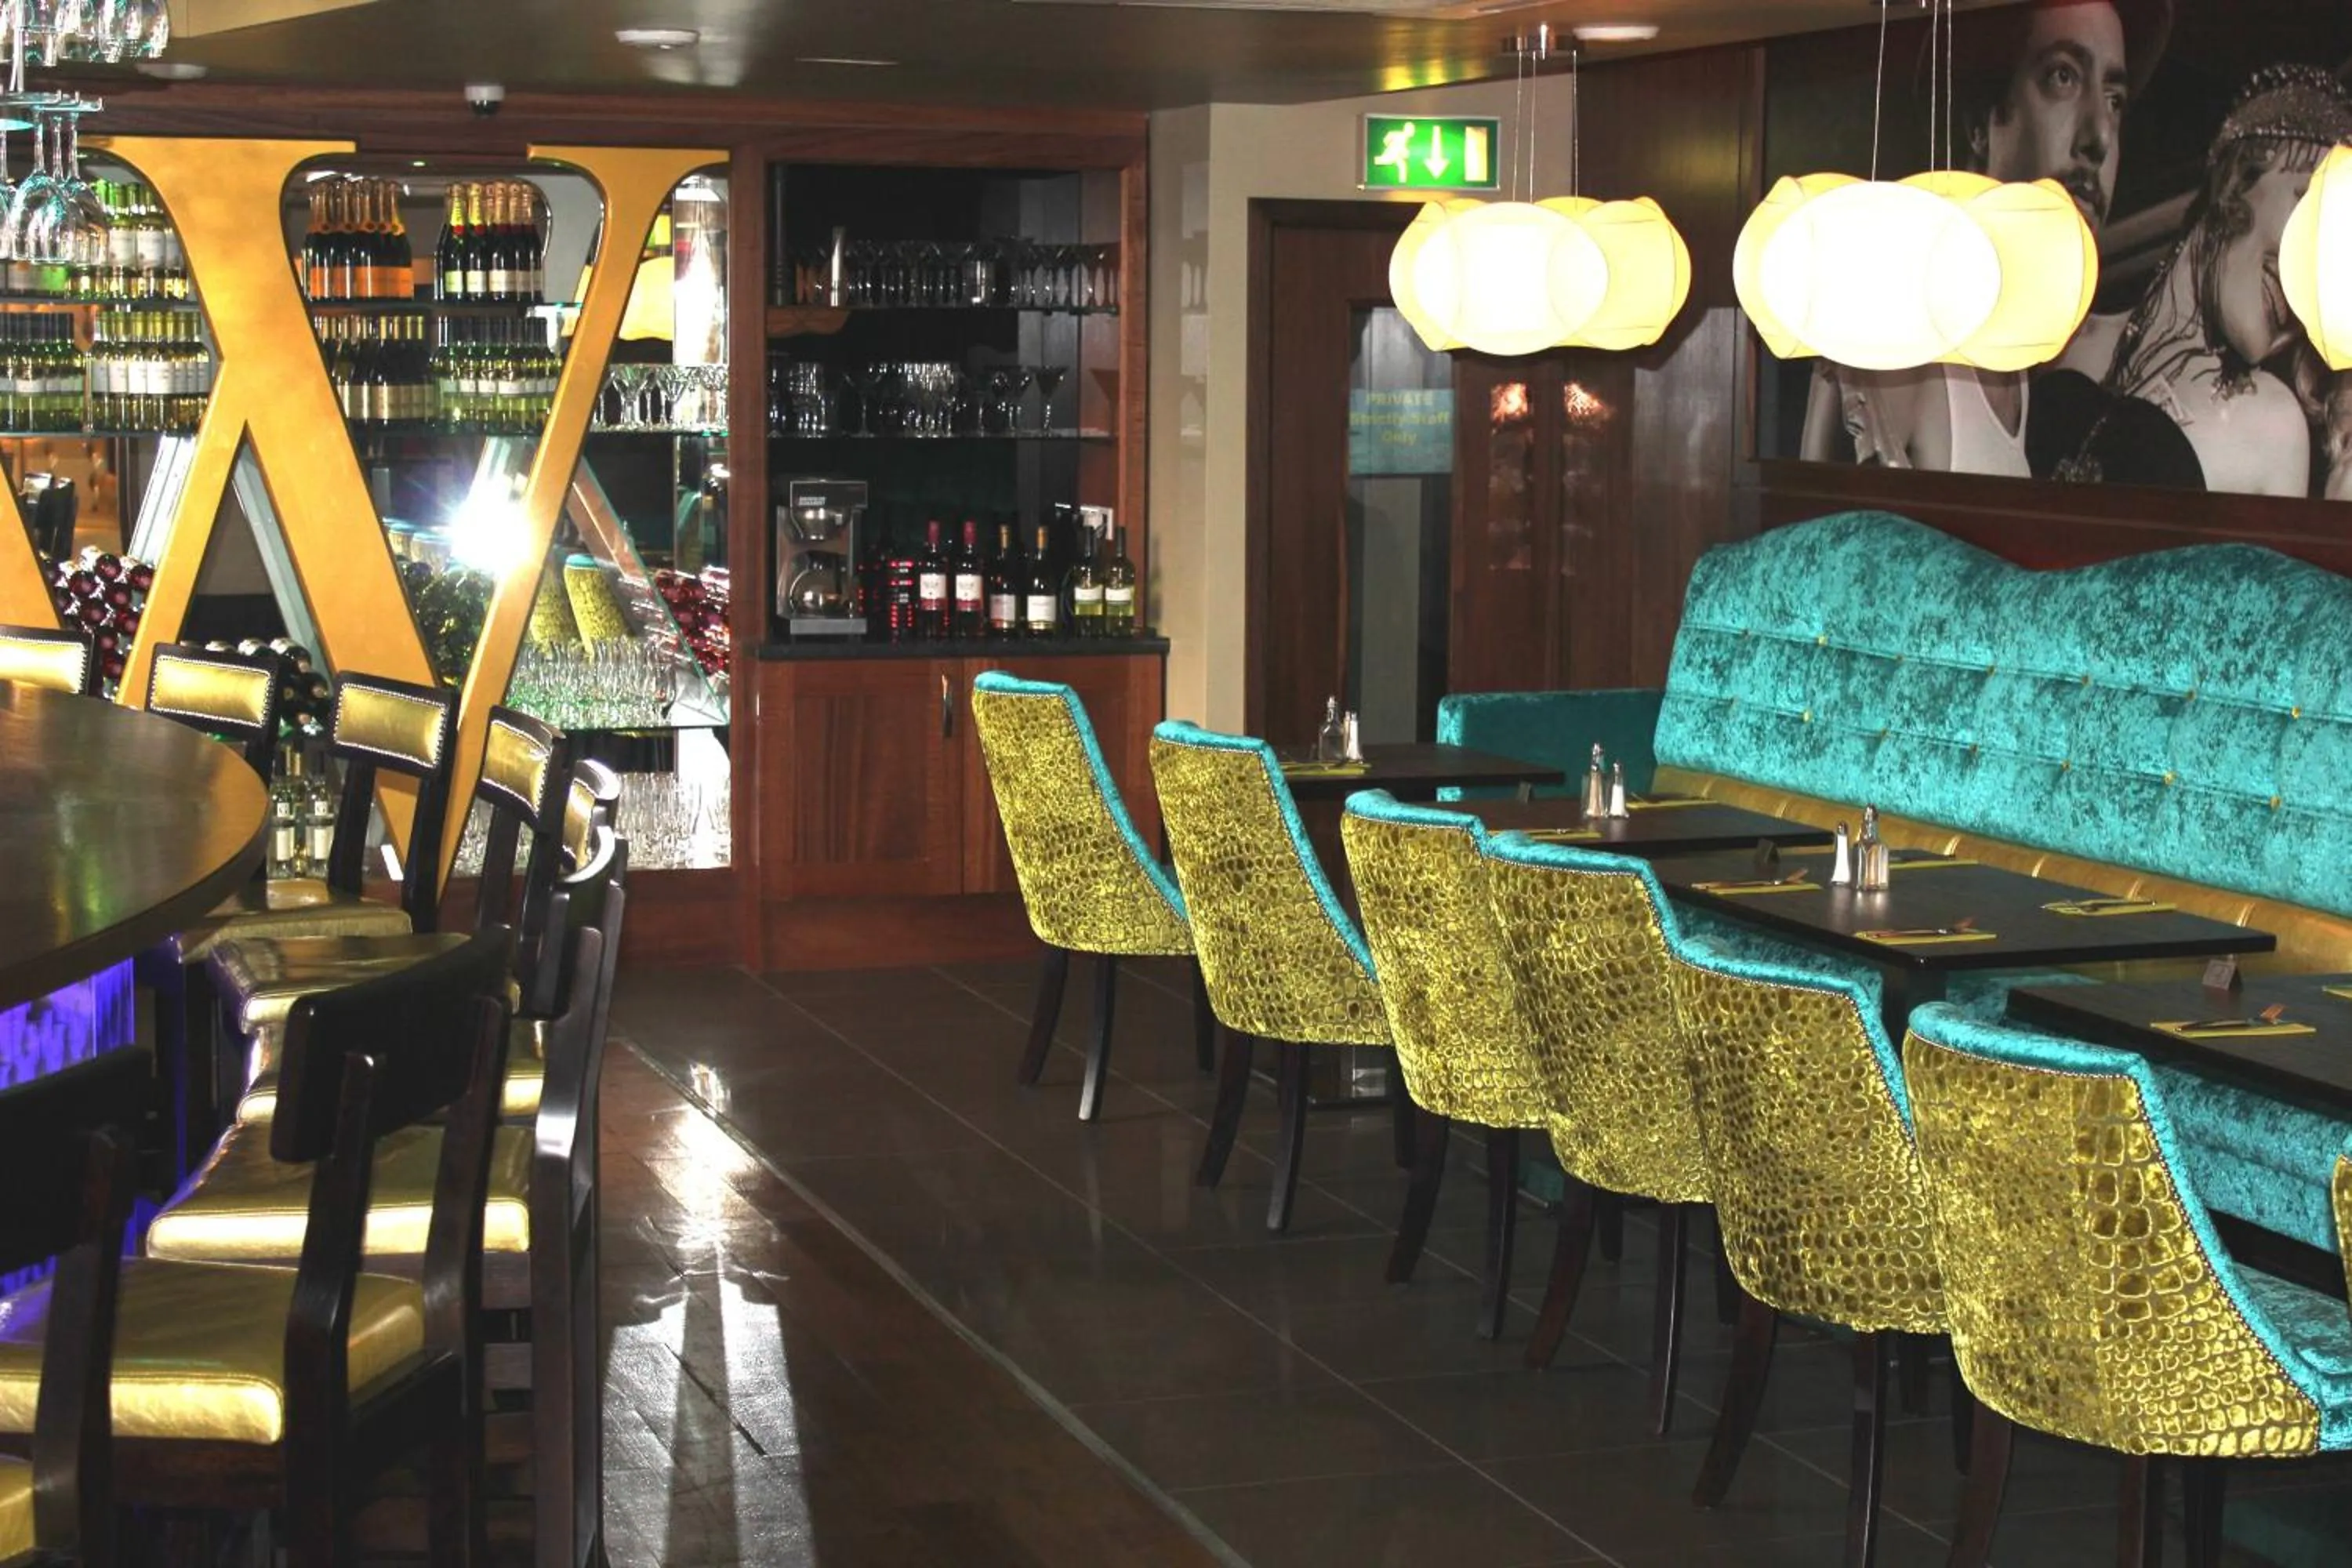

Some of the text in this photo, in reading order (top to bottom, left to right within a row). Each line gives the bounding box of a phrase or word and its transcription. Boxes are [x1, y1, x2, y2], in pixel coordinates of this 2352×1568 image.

[1366, 391, 1433, 406] PRIVATE
[1410, 410, 1450, 425] Staff
[1381, 430, 1417, 446] Only
